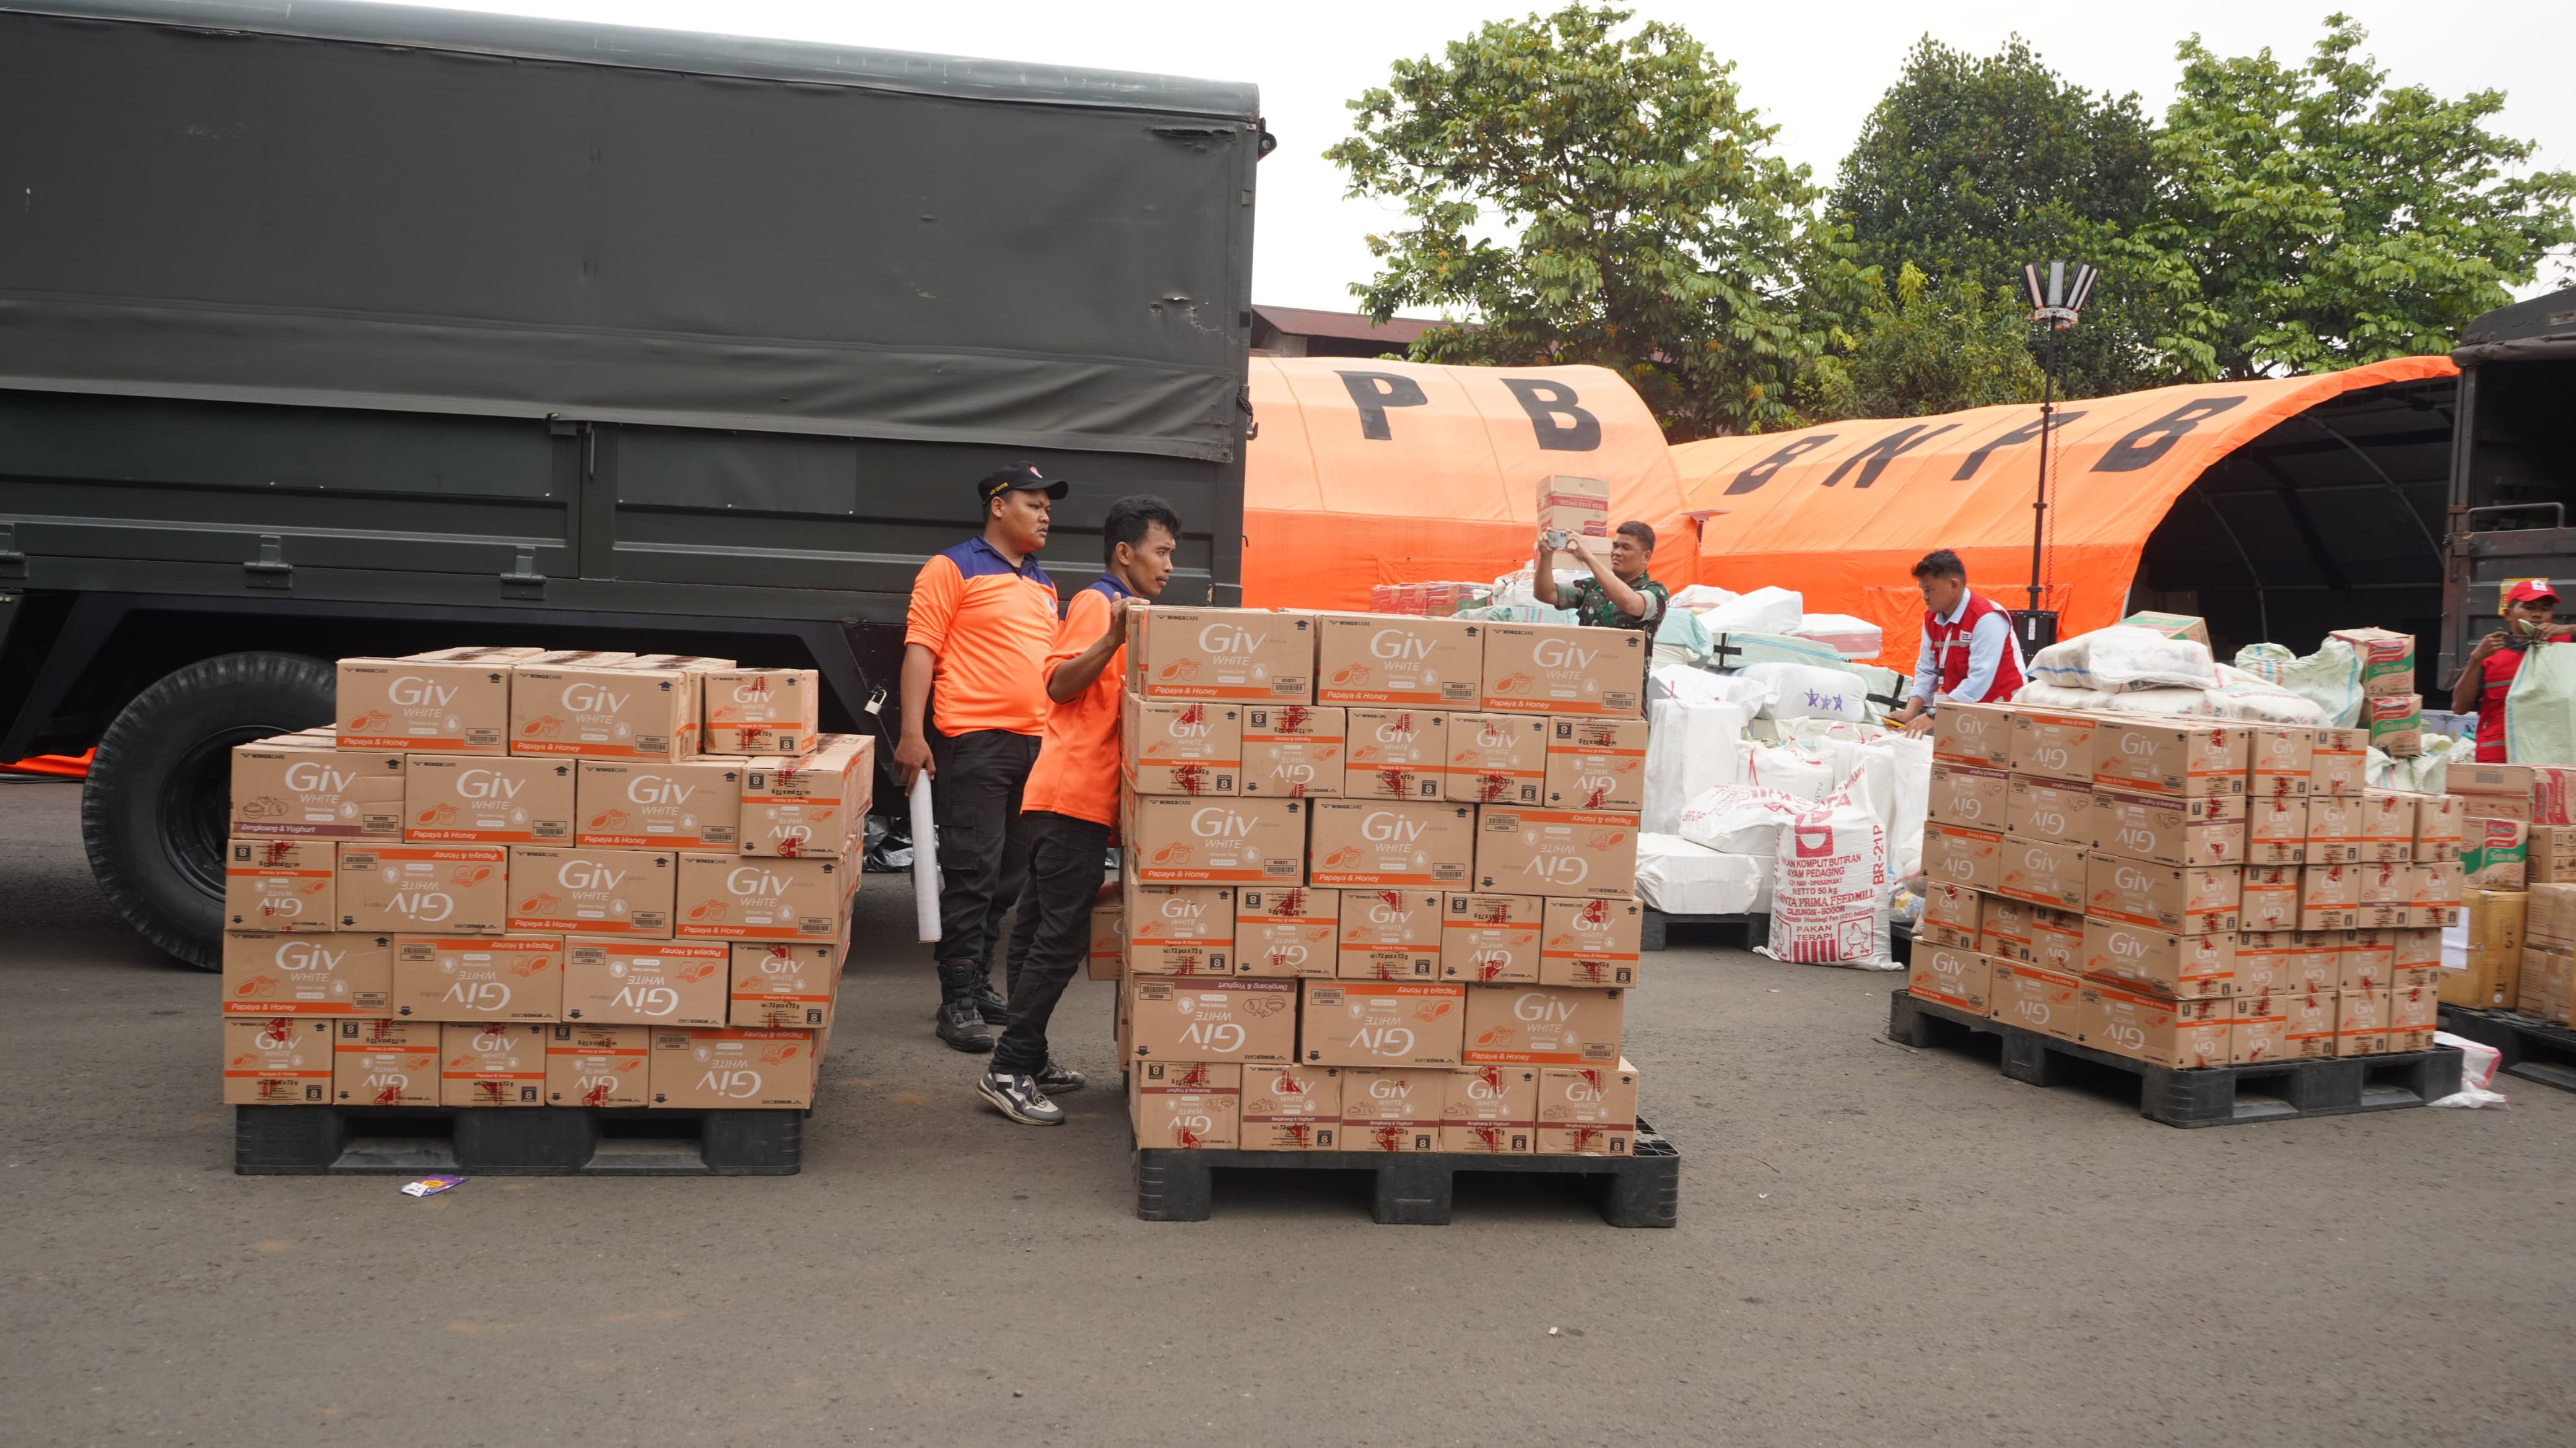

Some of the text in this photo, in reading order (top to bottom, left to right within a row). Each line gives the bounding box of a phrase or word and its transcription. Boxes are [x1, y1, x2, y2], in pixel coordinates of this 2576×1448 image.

[1723, 395, 2248, 496] BNPB
[1199, 623, 1266, 654] Giv
[1370, 629, 1437, 659] Giv
[1213, 656, 1250, 665] WHITE
[1533, 639, 1598, 668] Giv
[1384, 661, 1421, 670] WHITE
[1546, 670, 1582, 679] WHITE
[388, 677, 459, 706] Giv
[562, 683, 630, 713] Giv
[733, 686, 775, 704] Giv
[1155, 687, 1183, 695] Papaya
[1193, 687, 1217, 696] Honey
[1327, 691, 1354, 700] Papaya
[1363, 692, 1388, 700] Honey
[404, 708, 442, 717] WHITE
[575, 714, 614, 724] WHITE
[1169, 719, 1214, 738] Giv
[1956, 714, 1988, 735] Giv
[344, 738, 372, 747] Papaya
[383, 739, 409, 747] Honey
[518, 743, 545, 752] Papaya
[555, 744, 580, 753] Honey
[2121, 734, 2160, 758] Giv
[2273, 739, 2297, 753] Giv
[2031, 748, 2067, 770] Giv
[285, 763, 356, 792] Giv
[456, 770, 525, 798] Giv
[1270, 765, 1315, 784] Giv
[300, 794, 339, 803] WHITE
[628, 775, 695, 804] Giv
[471, 800, 509, 810] WHITE
[642, 807, 679, 816] WHITE
[1949, 798, 1981, 818] Giv
[287, 825, 315, 833] Yoghurt
[1191, 807, 1258, 837] Giv
[1362, 812, 1427, 841] Giv
[2029, 813, 2065, 835] Giv
[413, 831, 440, 840] Papaya
[585, 835, 611, 844] Papaya
[620, 836, 646, 844] Honey
[1204, 839, 1242, 848] WHITE
[2115, 831, 2155, 852] Giv
[239, 848, 246, 858] 8
[1376, 844, 1412, 852] WHITE
[1797, 859, 1827, 867] KOMPLIT
[1829, 854, 1861, 866] BUTIRAN
[1942, 861, 1974, 879] Giv
[2026, 849, 2061, 872] Giv
[559, 860, 625, 889] Giv
[1523, 856, 1588, 885] Giv
[1787, 867, 1845, 877] AYAM PEDAGING
[727, 867, 793, 896] Giv
[2115, 868, 2156, 893] Giv
[572, 891, 610, 901] WHITE
[740, 898, 778, 907] WHITE
[1799, 898, 1828, 907] PRIMA
[385, 893, 453, 921] Giv
[1162, 899, 1206, 918] Giv
[1368, 905, 1414, 924] Giv
[1822, 906, 1845, 914] BOGOR
[515, 920, 542, 929] Papaya
[2108, 932, 2149, 958] Giv
[276, 942, 346, 971] Giv
[760, 956, 805, 973] Giv
[1932, 952, 1965, 977] Giv
[291, 973, 329, 981] WHITE
[442, 983, 510, 1010] Giv
[611, 987, 678, 1015] Giv
[811, 1013, 818, 1021] 8
[1194, 1012, 1232, 1021] WHITE
[1514, 994, 1578, 1021] Giv
[2014, 1004, 2050, 1025] Giv
[1179, 1023, 1245, 1052] Giv
[1526, 1024, 1562, 1033] WHITE
[2103, 1025, 2144, 1049] Giv
[1349, 1028, 1414, 1056] Giv
[696, 1071, 762, 1098] Giv
[1370, 1080, 1414, 1098] Giv
[1565, 1083, 1609, 1101] Giv
[1321, 1134, 1328, 1142] 8
